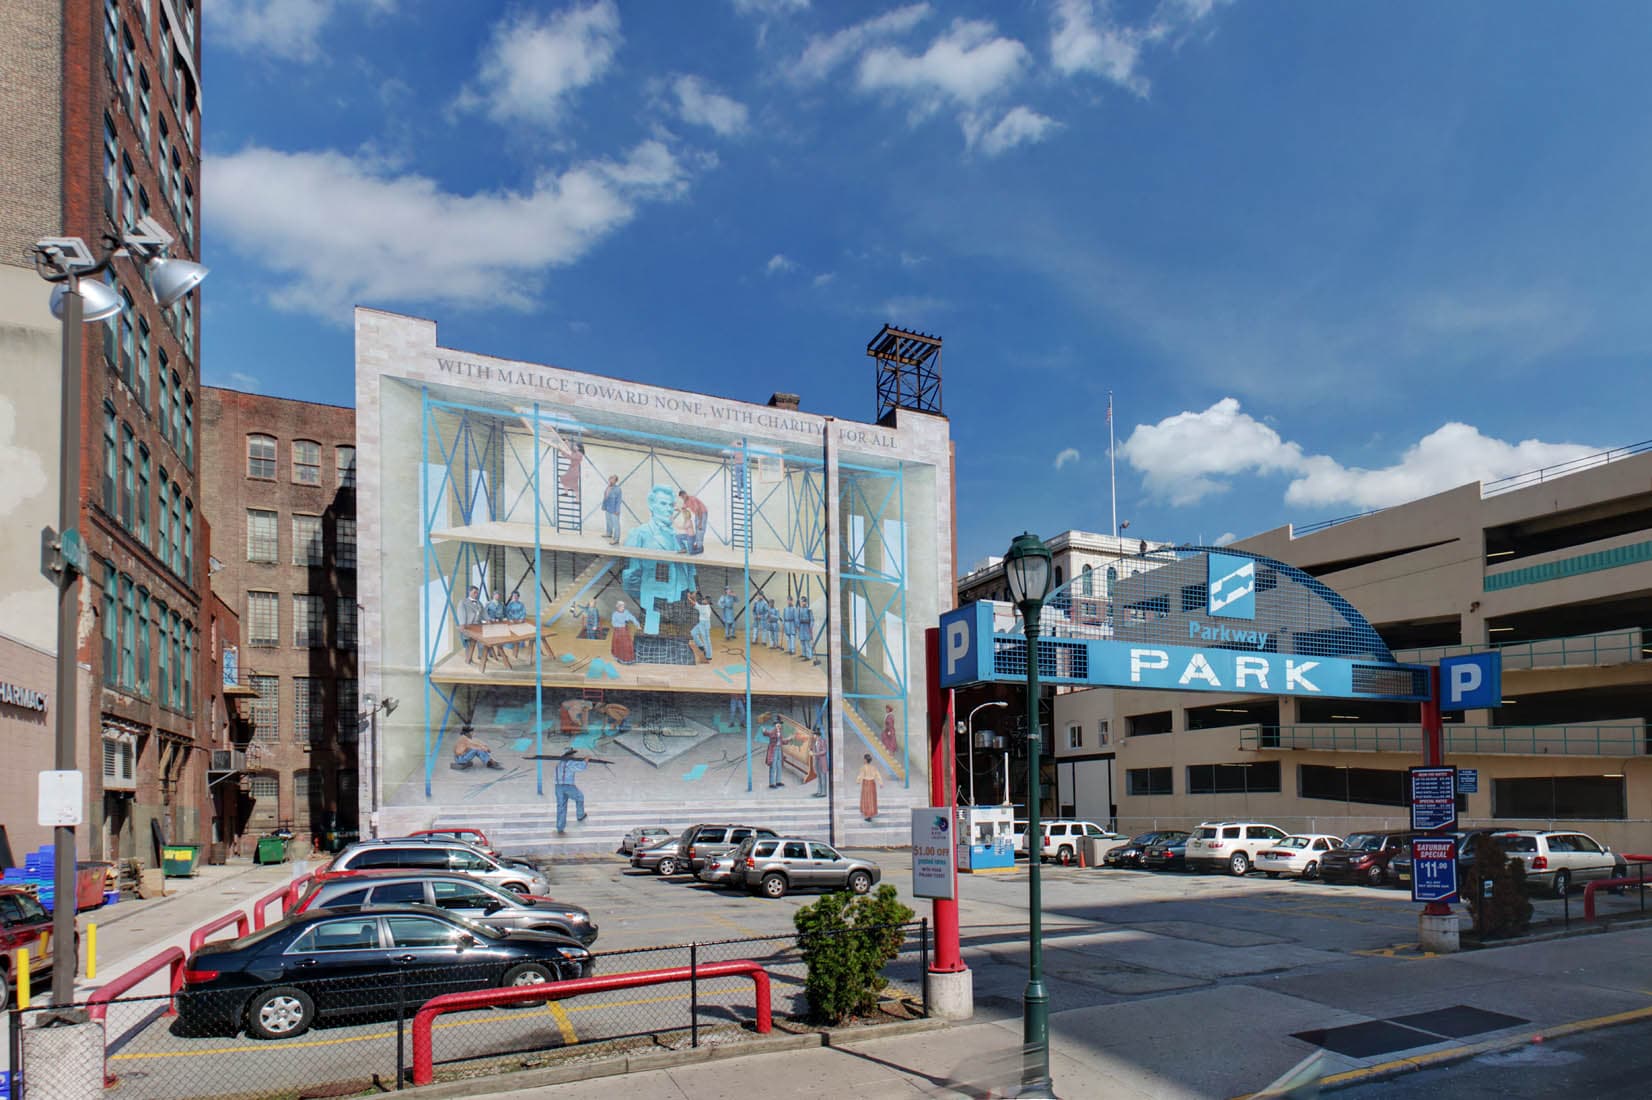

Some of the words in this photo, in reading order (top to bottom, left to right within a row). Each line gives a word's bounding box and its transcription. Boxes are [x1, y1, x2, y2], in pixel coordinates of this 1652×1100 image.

[437, 358, 490, 380] WITH
[498, 368, 569, 393] MALICE
[574, 380, 648, 405] TOWARD
[655, 396, 707, 418] NONE,
[710, 405, 753, 424] WITH
[757, 414, 823, 436] CHARITY
[839, 427, 867, 444] FOR
[872, 434, 898, 449] ALL
[946, 619, 970, 676] P
[1188, 620, 1269, 650] Parkway
[1129, 648, 1322, 692] PARK
[1450, 663, 1482, 703] P
[913, 845, 935, 857] $1.00
[1416, 843, 1451, 852] SATURDAY
